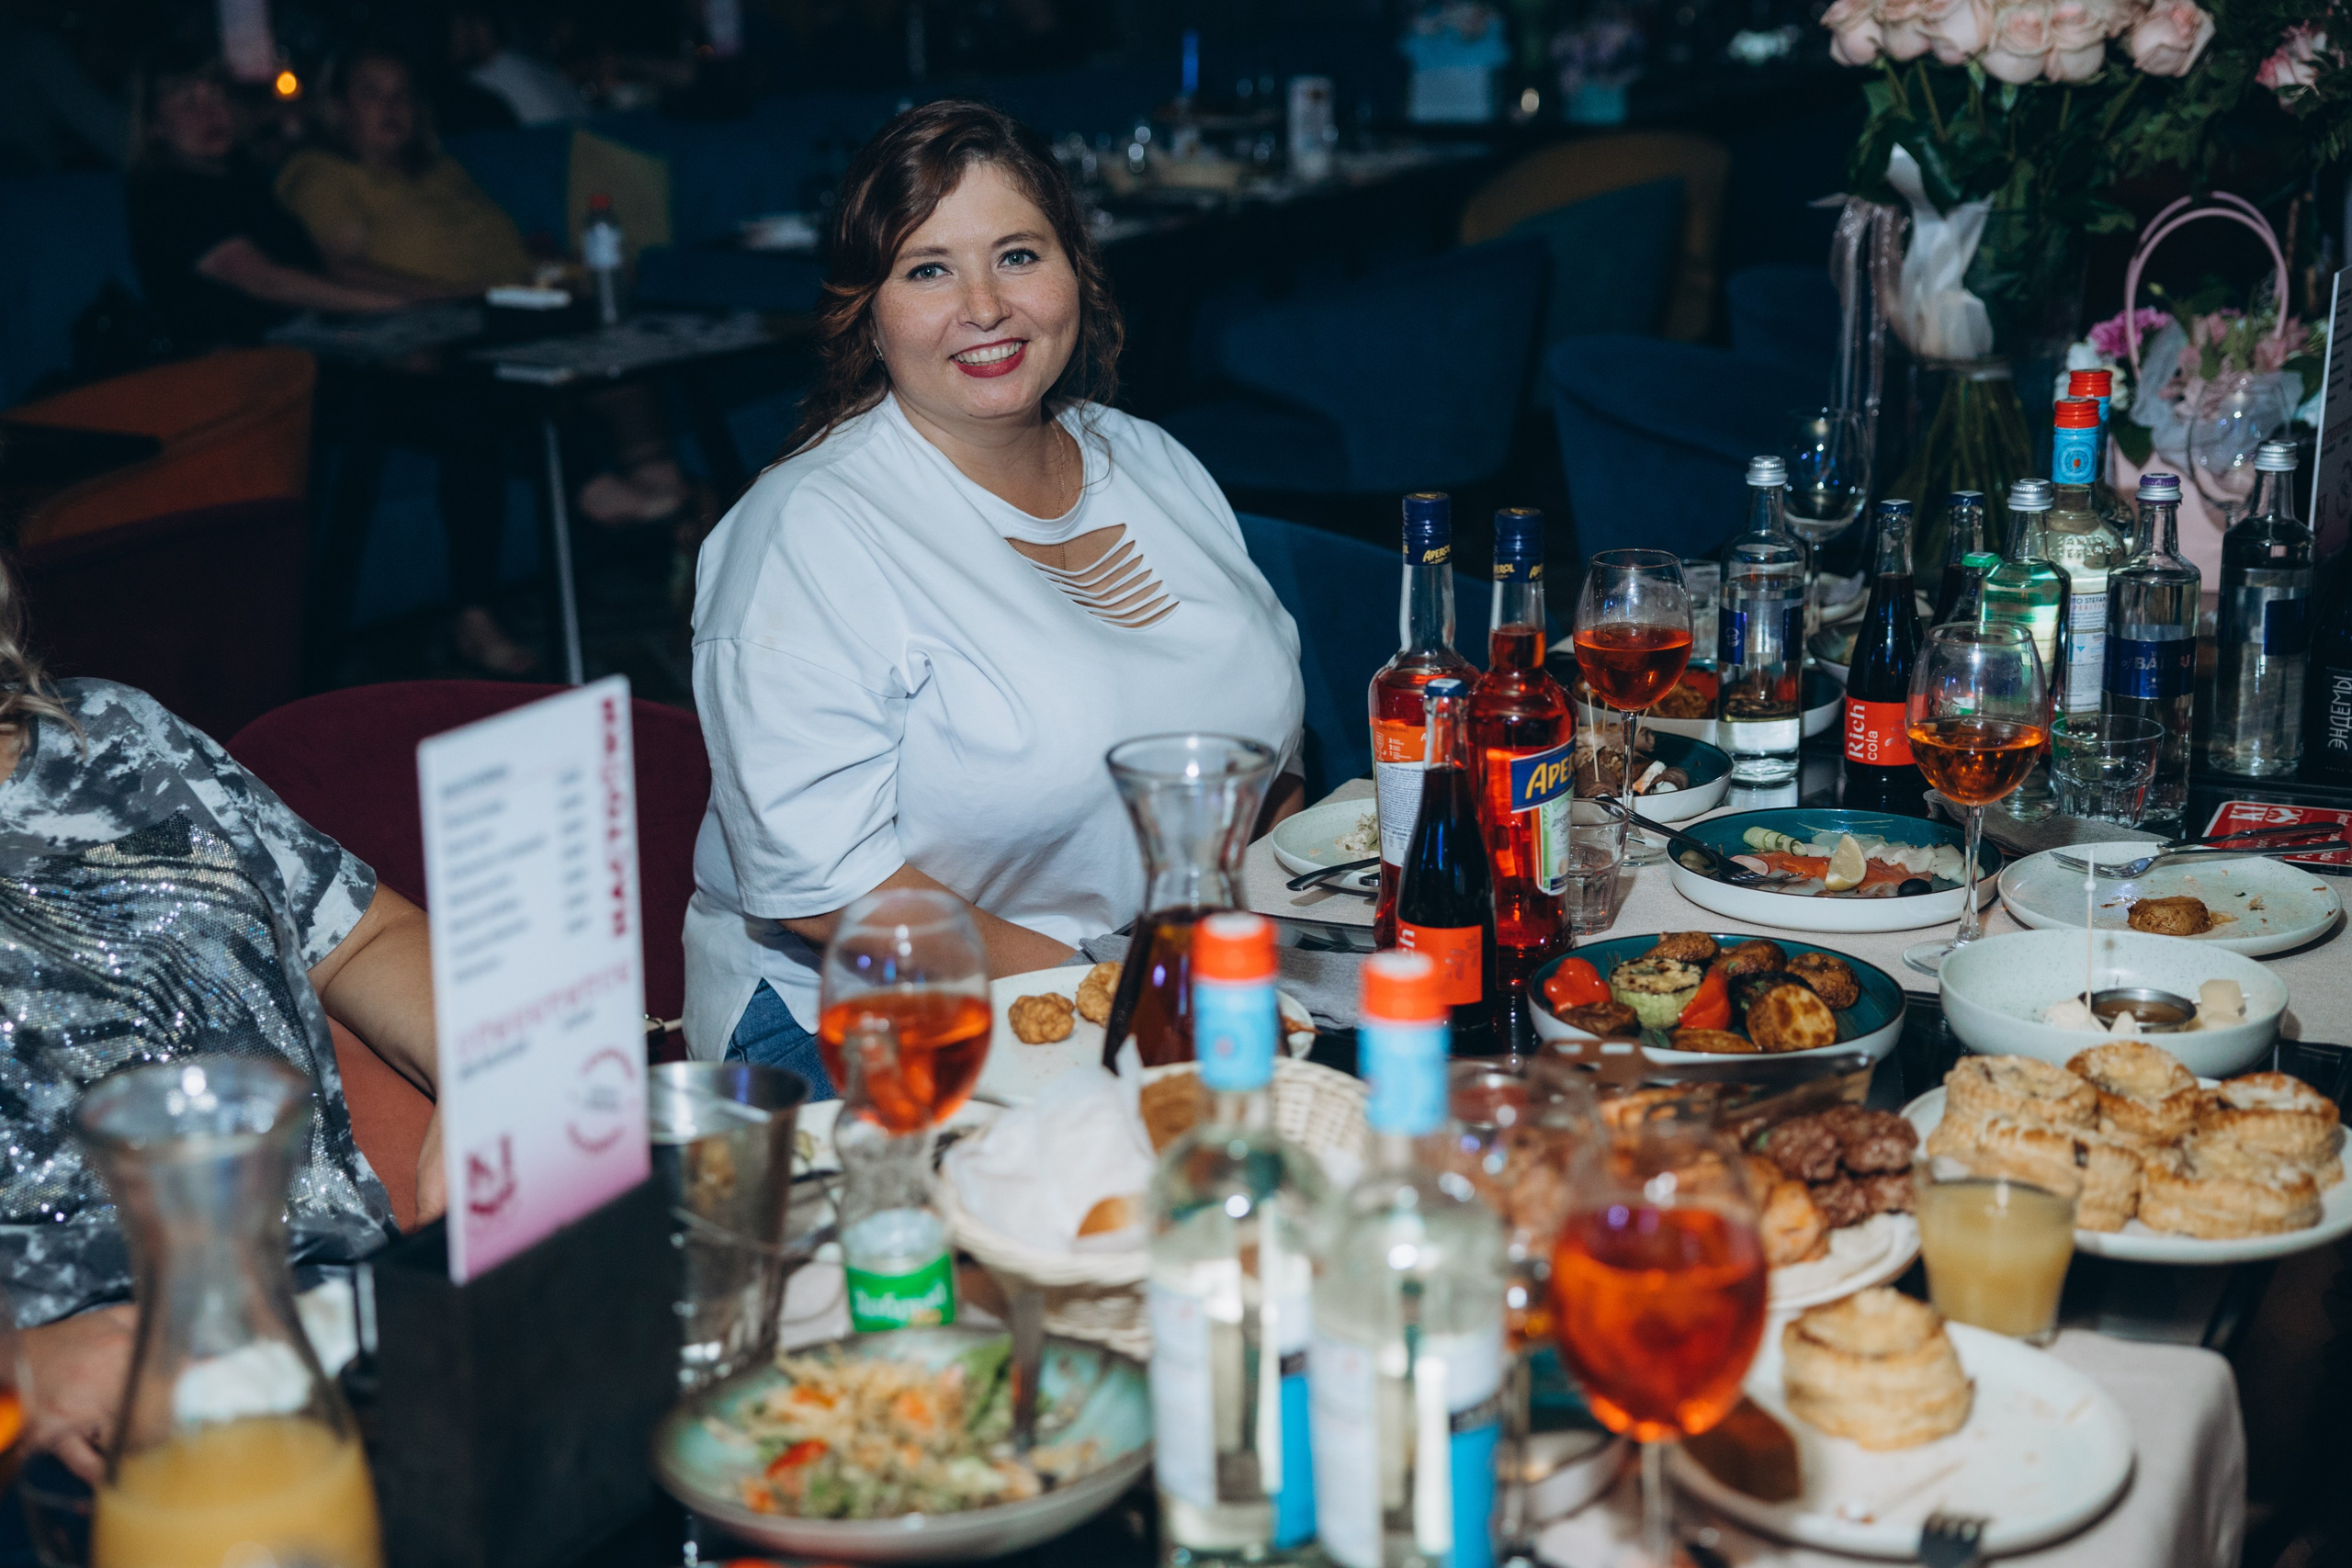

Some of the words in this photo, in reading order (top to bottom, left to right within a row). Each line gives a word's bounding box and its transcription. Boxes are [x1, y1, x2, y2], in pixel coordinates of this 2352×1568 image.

[1849, 705, 1865, 759] Rich
[2327, 675, 2352, 750] ЭНДЕМЫ
[1865, 730, 1879, 761] cola
